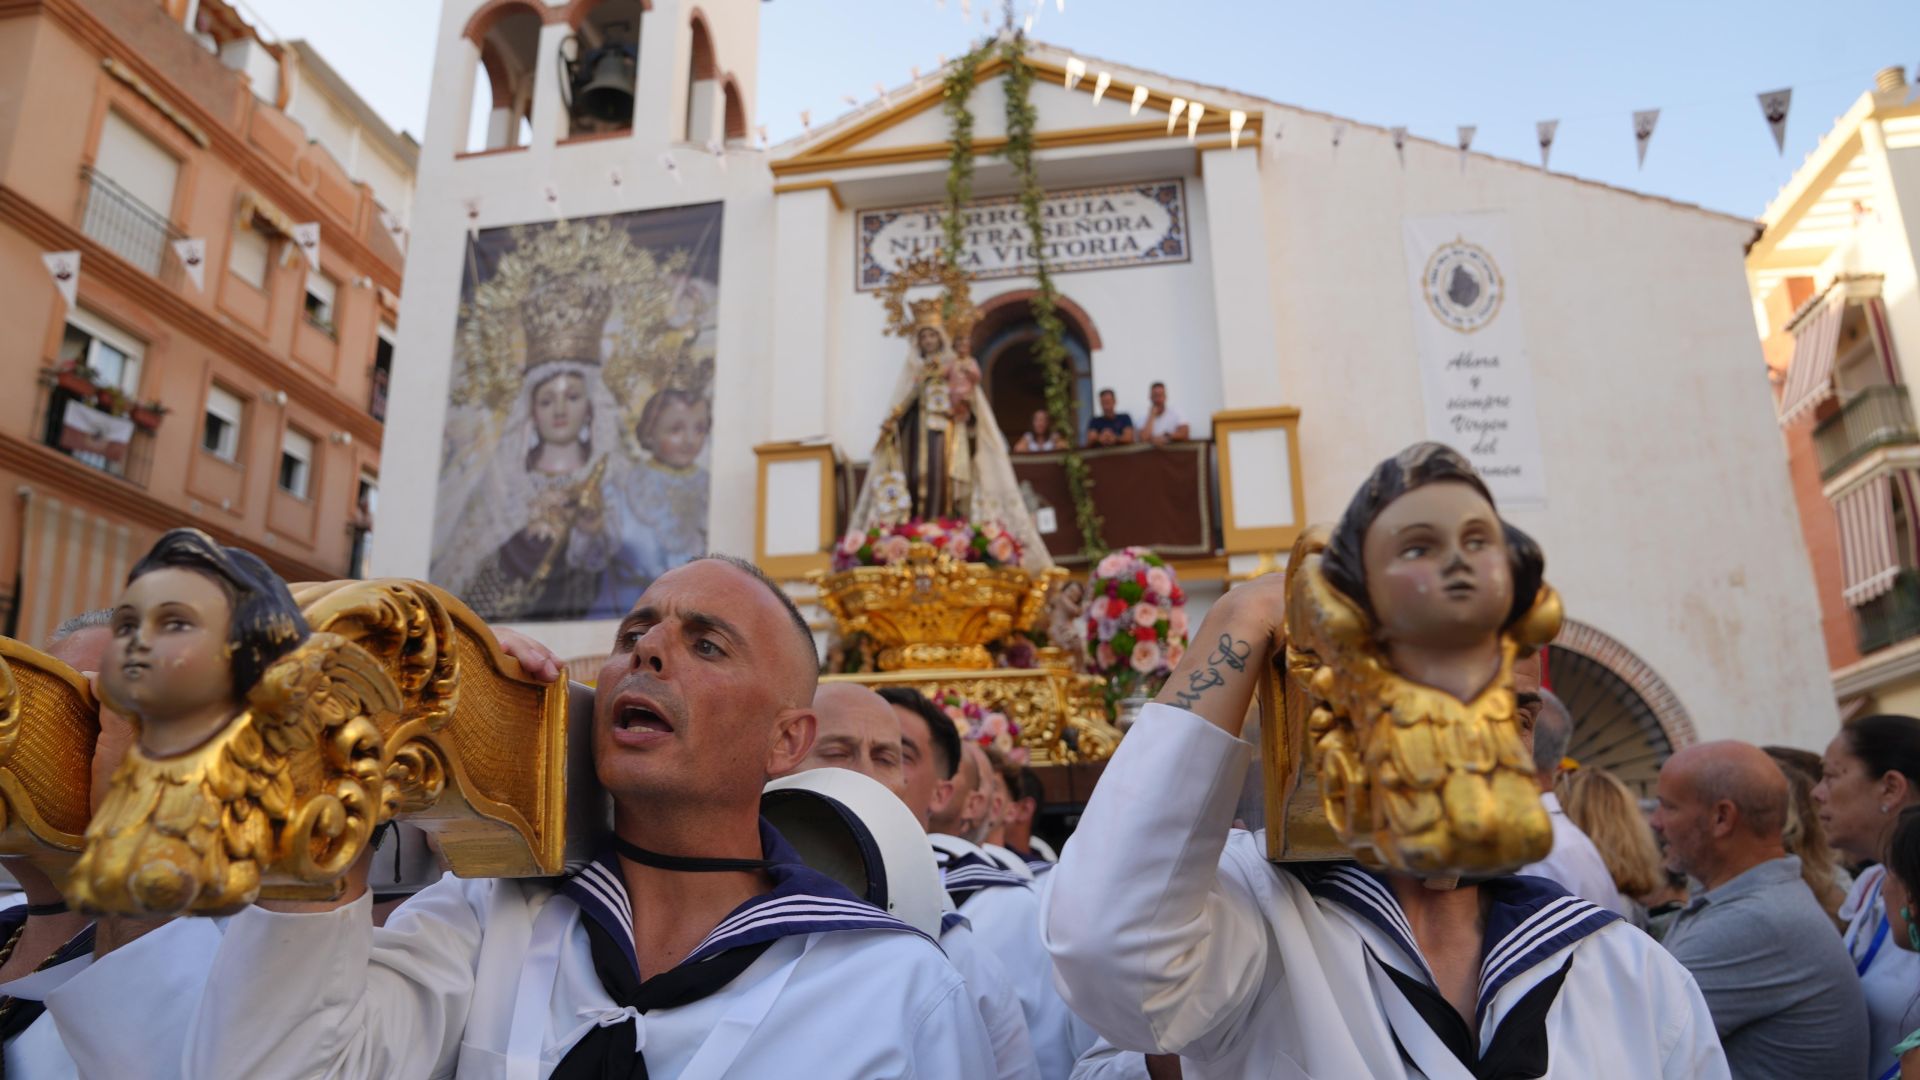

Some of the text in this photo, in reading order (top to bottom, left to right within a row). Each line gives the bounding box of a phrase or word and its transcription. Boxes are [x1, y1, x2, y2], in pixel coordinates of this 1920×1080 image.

[923, 199, 1116, 230] PRROQUIA
[887, 214, 1154, 256] NUETRA SEÑORA
[993, 235, 1140, 265] VICTORIA
[1450, 413, 1509, 437] Virgen
